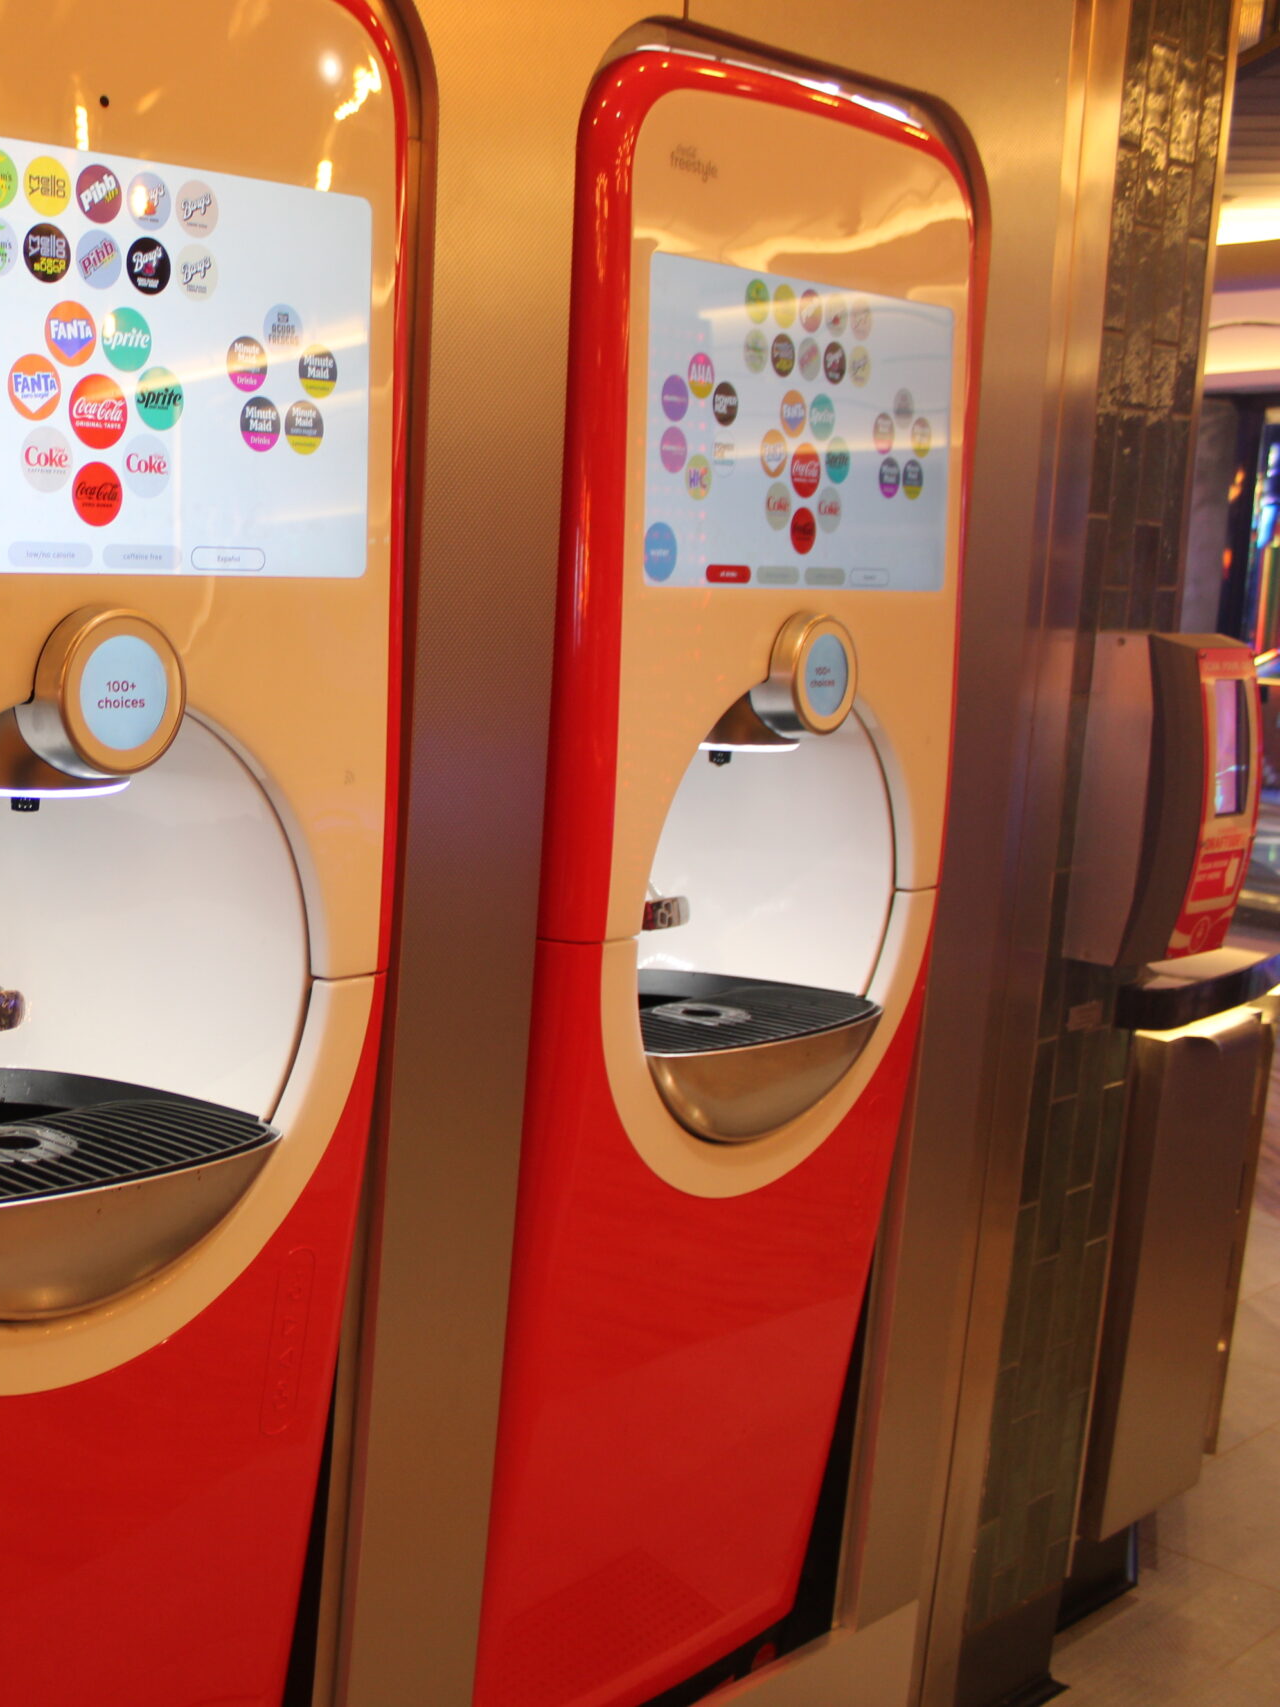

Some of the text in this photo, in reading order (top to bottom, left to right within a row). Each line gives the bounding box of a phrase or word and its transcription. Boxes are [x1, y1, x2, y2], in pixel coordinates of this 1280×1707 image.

[80, 174, 116, 212] Pibb
[182, 193, 212, 221] Barq's
[80, 239, 115, 278] Pibb
[132, 246, 162, 273] Barq's
[182, 256, 211, 285] Barq's
[103, 328, 150, 350] Sprite
[234, 342, 260, 354] Minute
[303, 355, 333, 369] Minute
[307, 366, 329, 379] Maid
[237, 376, 257, 385] Drinks
[136, 387, 182, 409] Sprite
[72, 397, 126, 421] Coca-Cola
[245, 406, 277, 420] Minute
[291, 407, 316, 418] Minute
[249, 419, 272, 432] Maid
[295, 417, 313, 427] Maid
[250, 436, 271, 445] Drinks
[25, 445, 69, 468] Coke
[126, 452, 167, 474] Coke
[75, 481, 119, 501] Coca-Cola
[122, 552, 163, 561] caffeine free
[105, 680, 137, 693] 100+
[97, 696, 145, 709] choices
